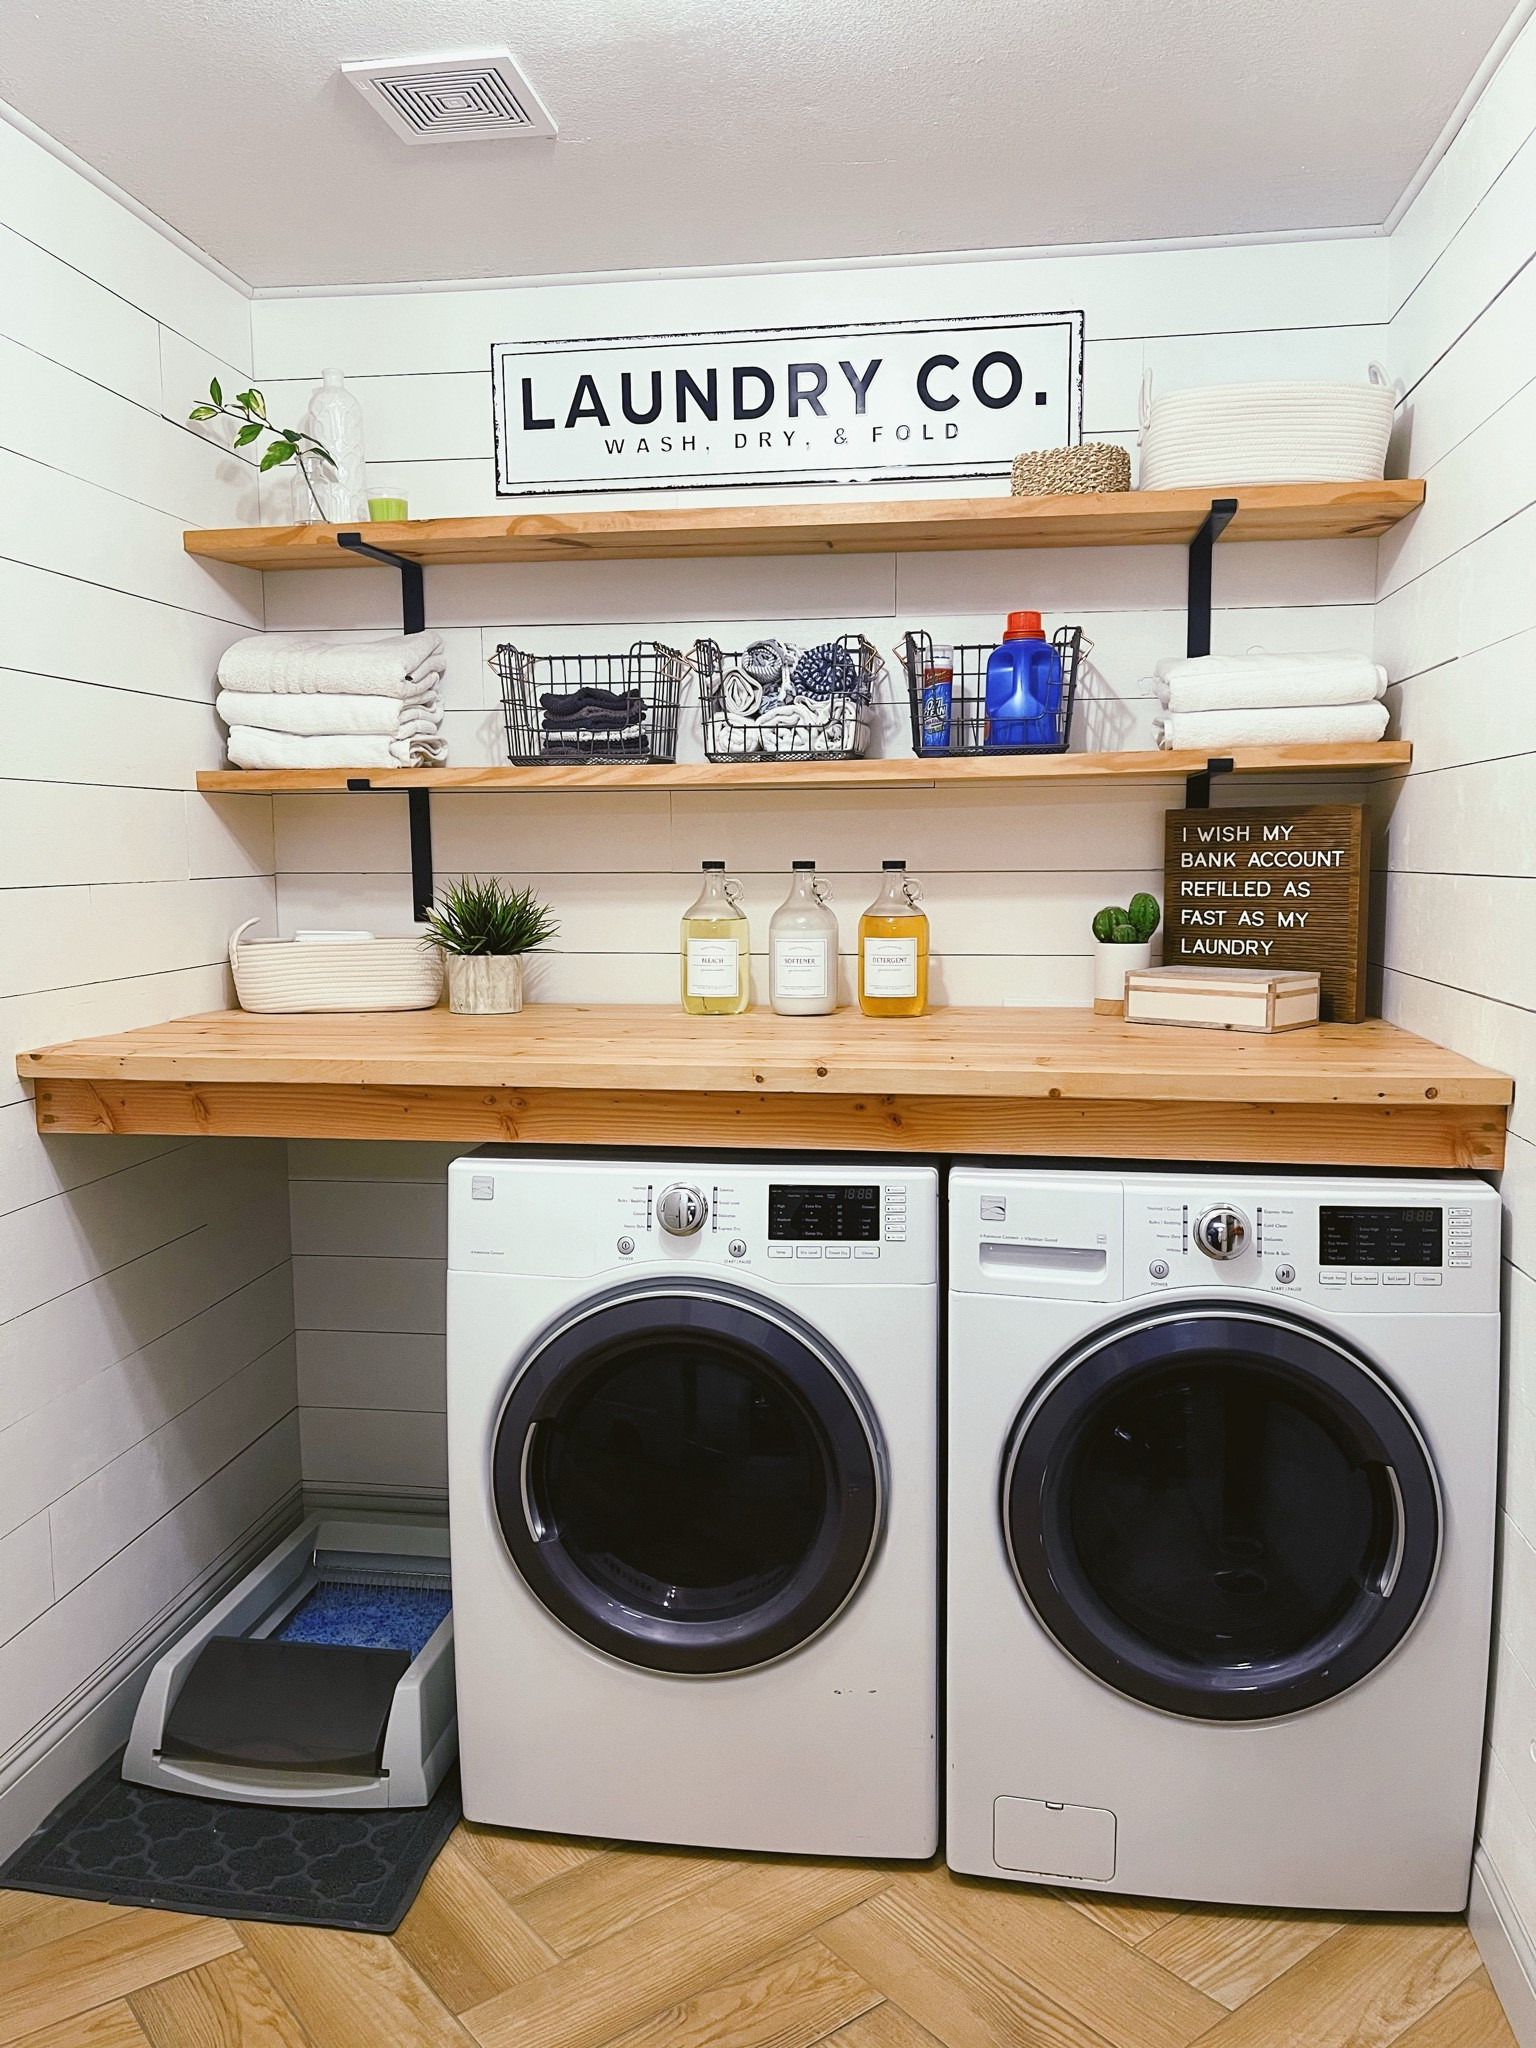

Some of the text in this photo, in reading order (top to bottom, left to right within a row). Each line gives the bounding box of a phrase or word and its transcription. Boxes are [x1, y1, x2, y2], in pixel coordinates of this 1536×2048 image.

[523, 351, 1047, 430] LAUNDRY CO.
[605, 423, 959, 455] WASH, DRY, & FOLD
[1183, 825, 1293, 842] I WISH MY
[1181, 850, 1344, 868] BANK ACCOUNT
[1181, 881, 1310, 897] REFILLED AS
[1181, 909, 1309, 928] FAST AS MY
[1181, 938, 1273, 955] LAUNDRY
